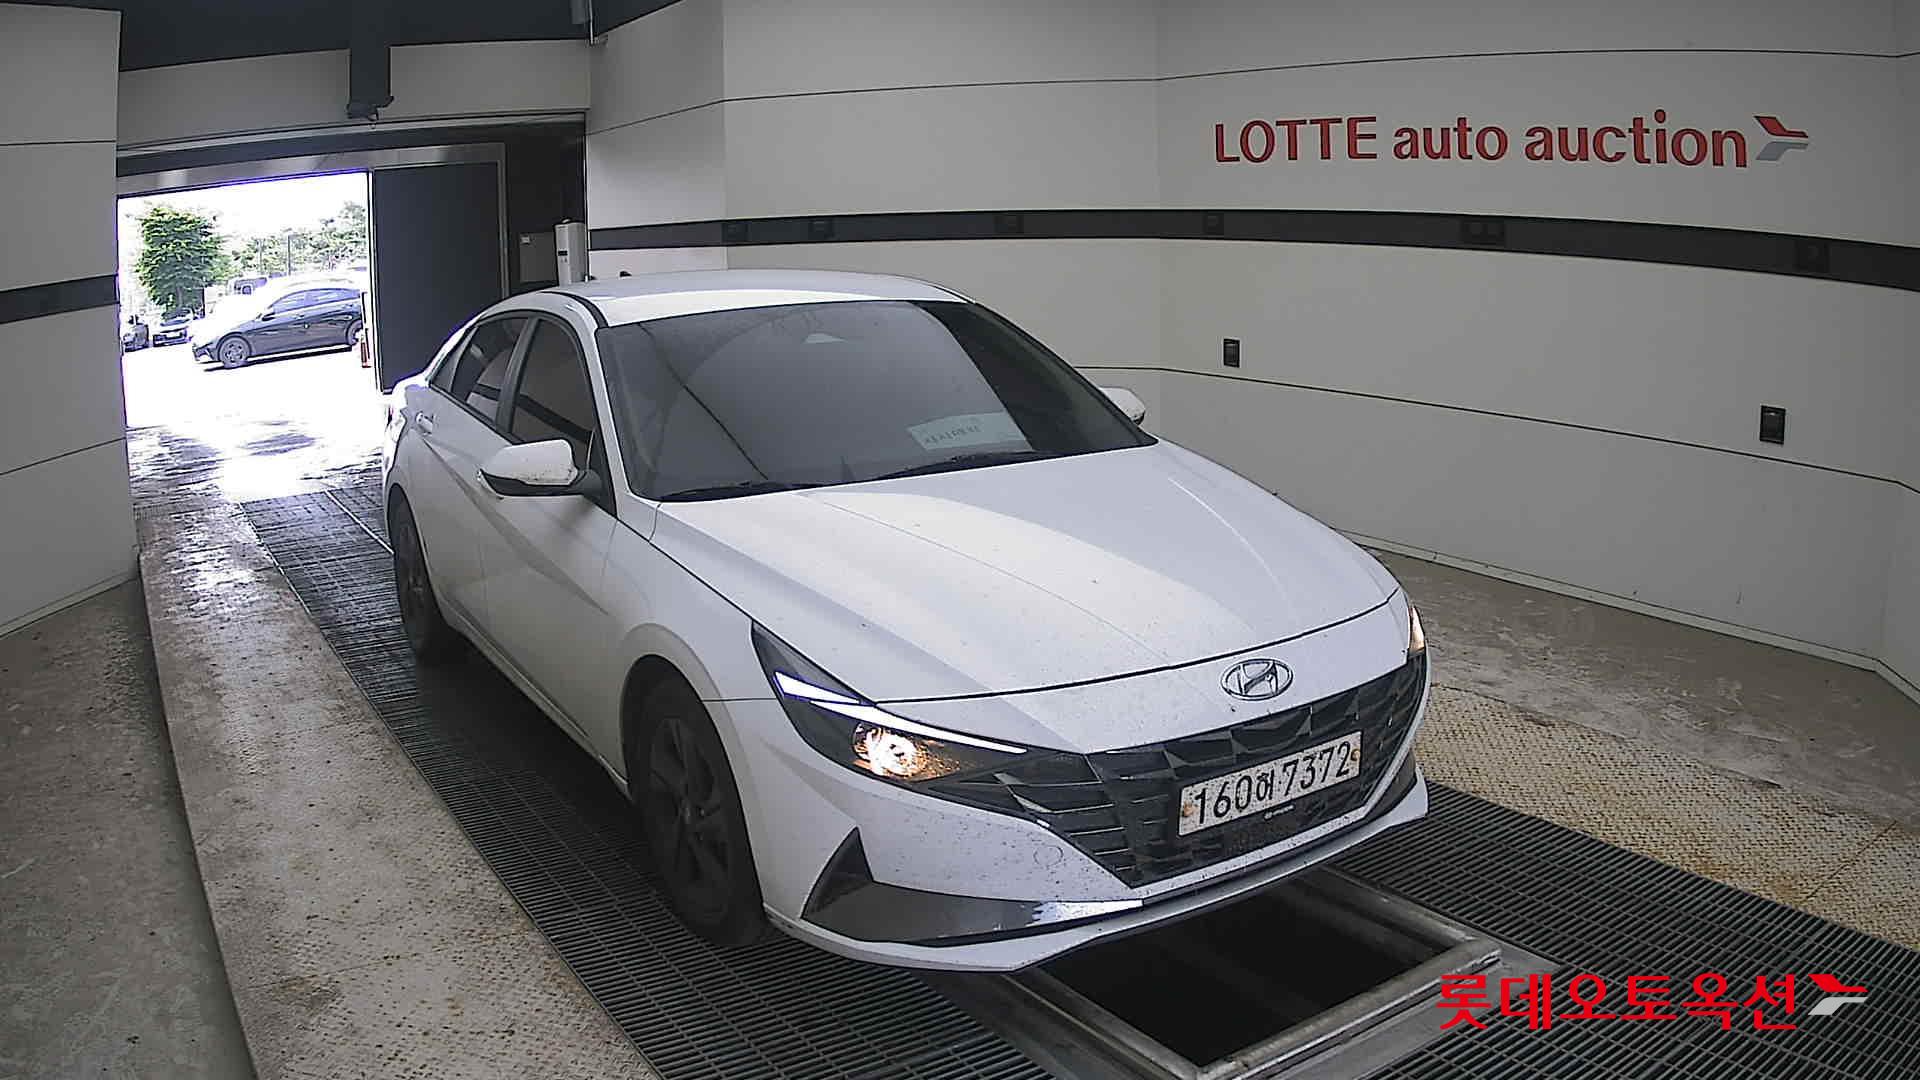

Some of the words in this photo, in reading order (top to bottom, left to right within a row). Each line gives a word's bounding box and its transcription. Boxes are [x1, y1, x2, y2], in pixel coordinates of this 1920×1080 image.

[1214, 116, 1377, 163] LOTTE
[1392, 117, 1508, 161] auto
[1524, 109, 1748, 168] auction
